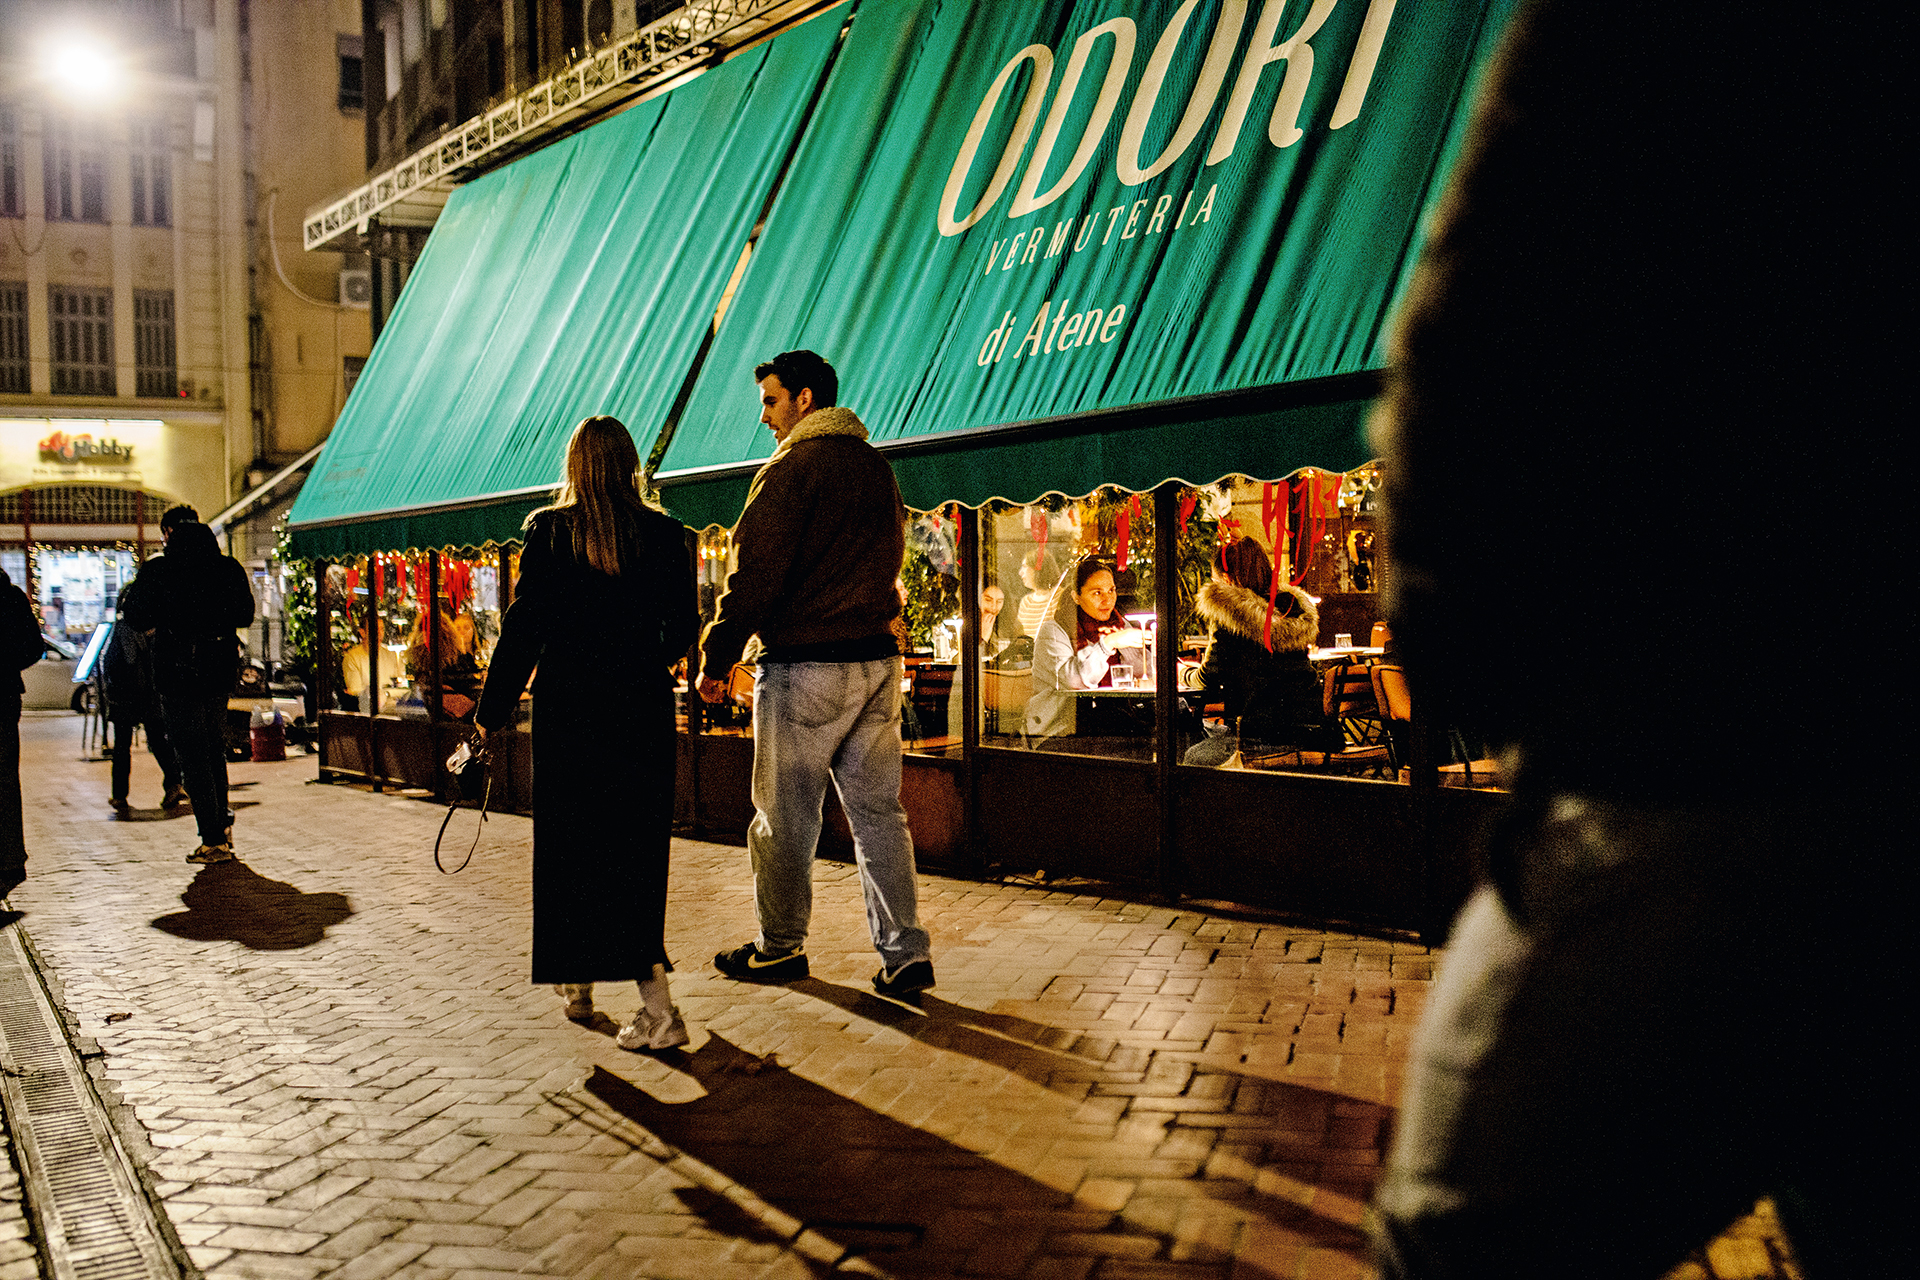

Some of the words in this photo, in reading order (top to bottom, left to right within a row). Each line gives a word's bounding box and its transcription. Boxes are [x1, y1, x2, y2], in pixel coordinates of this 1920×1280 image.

[984, 183, 1218, 276] VERMUTERIA
[977, 312, 1013, 367] di
[1013, 298, 1127, 359] Atene
[73, 438, 134, 461] Hobby
